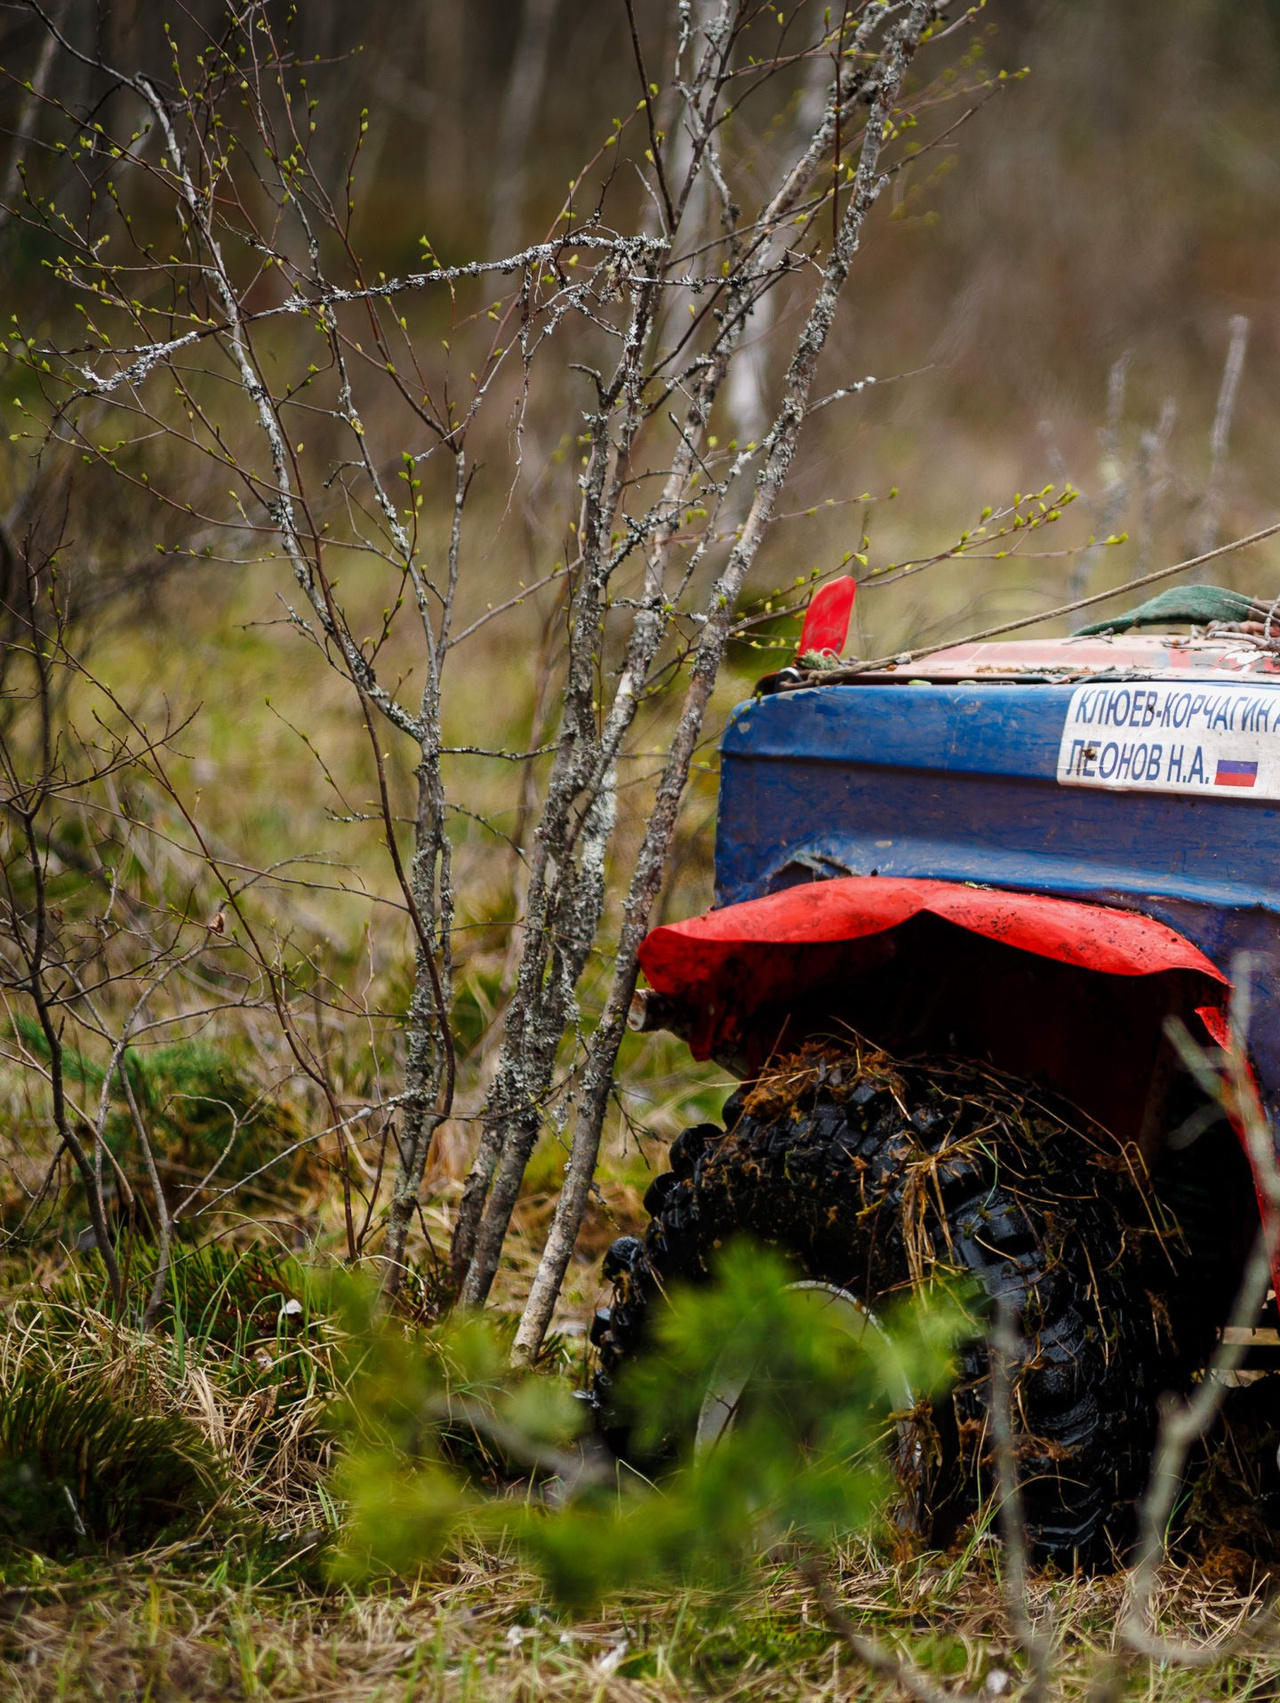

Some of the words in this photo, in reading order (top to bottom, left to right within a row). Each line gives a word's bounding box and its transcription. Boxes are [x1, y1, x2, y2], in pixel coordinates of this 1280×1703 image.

[1075, 689, 1270, 734] КЛЮЕВ-КОРЧАГИН
[1066, 739, 1161, 781] ЛЕОНОВ
[1167, 744, 1210, 785] Н.А.
